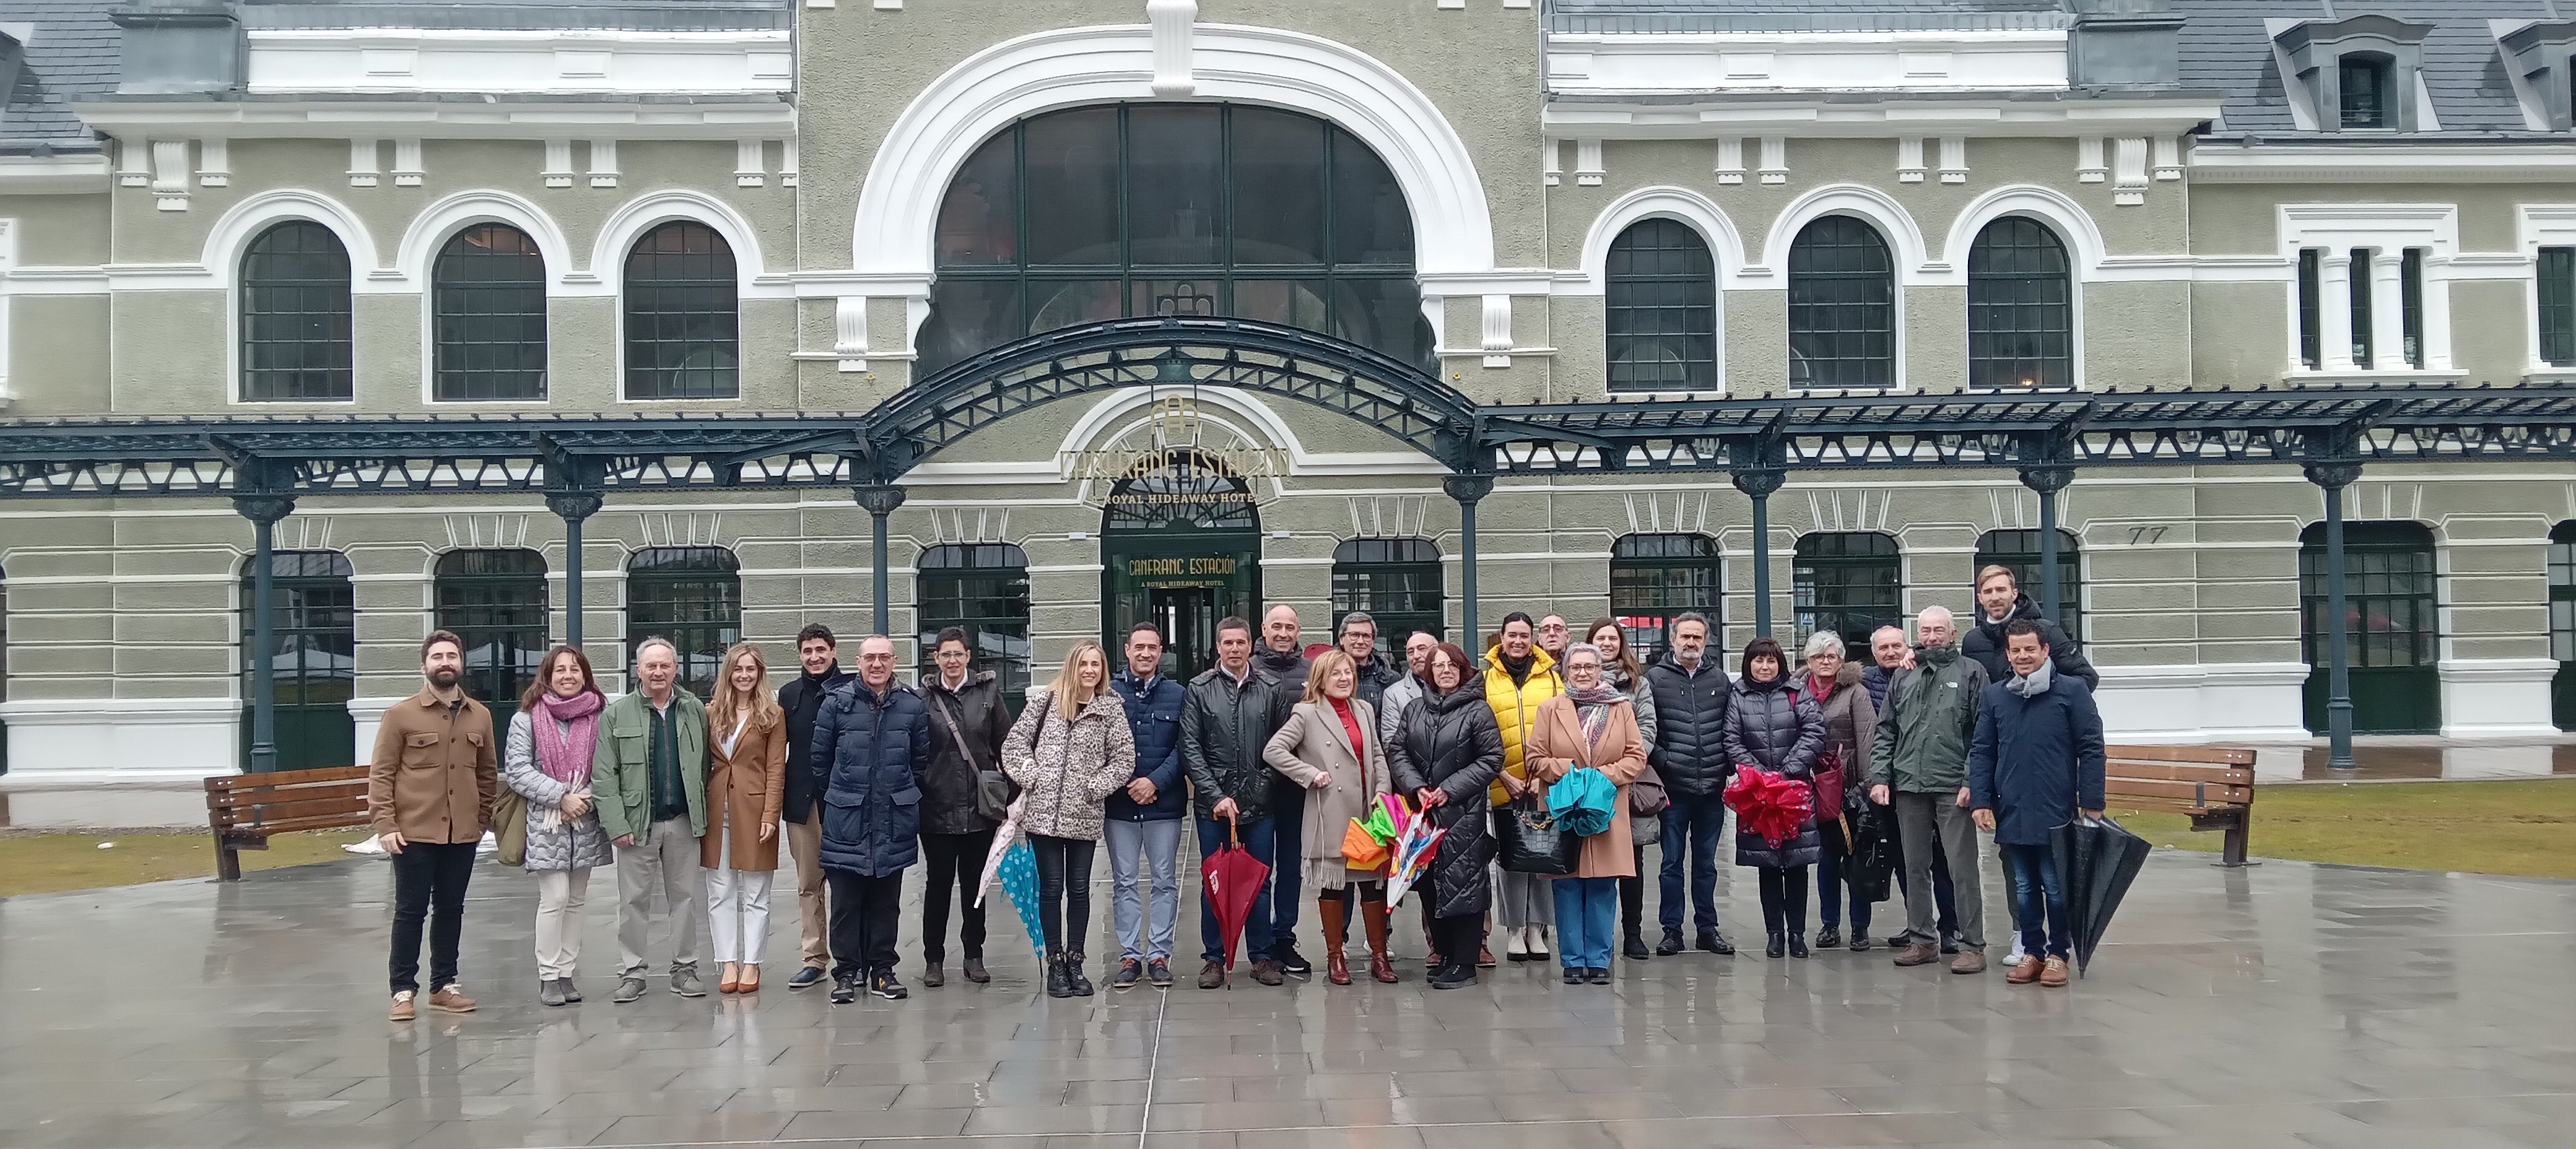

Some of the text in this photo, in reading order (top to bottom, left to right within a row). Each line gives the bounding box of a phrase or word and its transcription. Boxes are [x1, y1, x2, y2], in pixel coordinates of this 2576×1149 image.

[1060, 441, 1290, 480] CANFRANC ESTACIÓN
[1092, 495, 1097, 503] A
[1103, 495, 1144, 505] ROYAL
[1148, 494, 1216, 504] HIDEAWAY
[1129, 555, 1236, 576] CANFRANC ESTACIÓN
